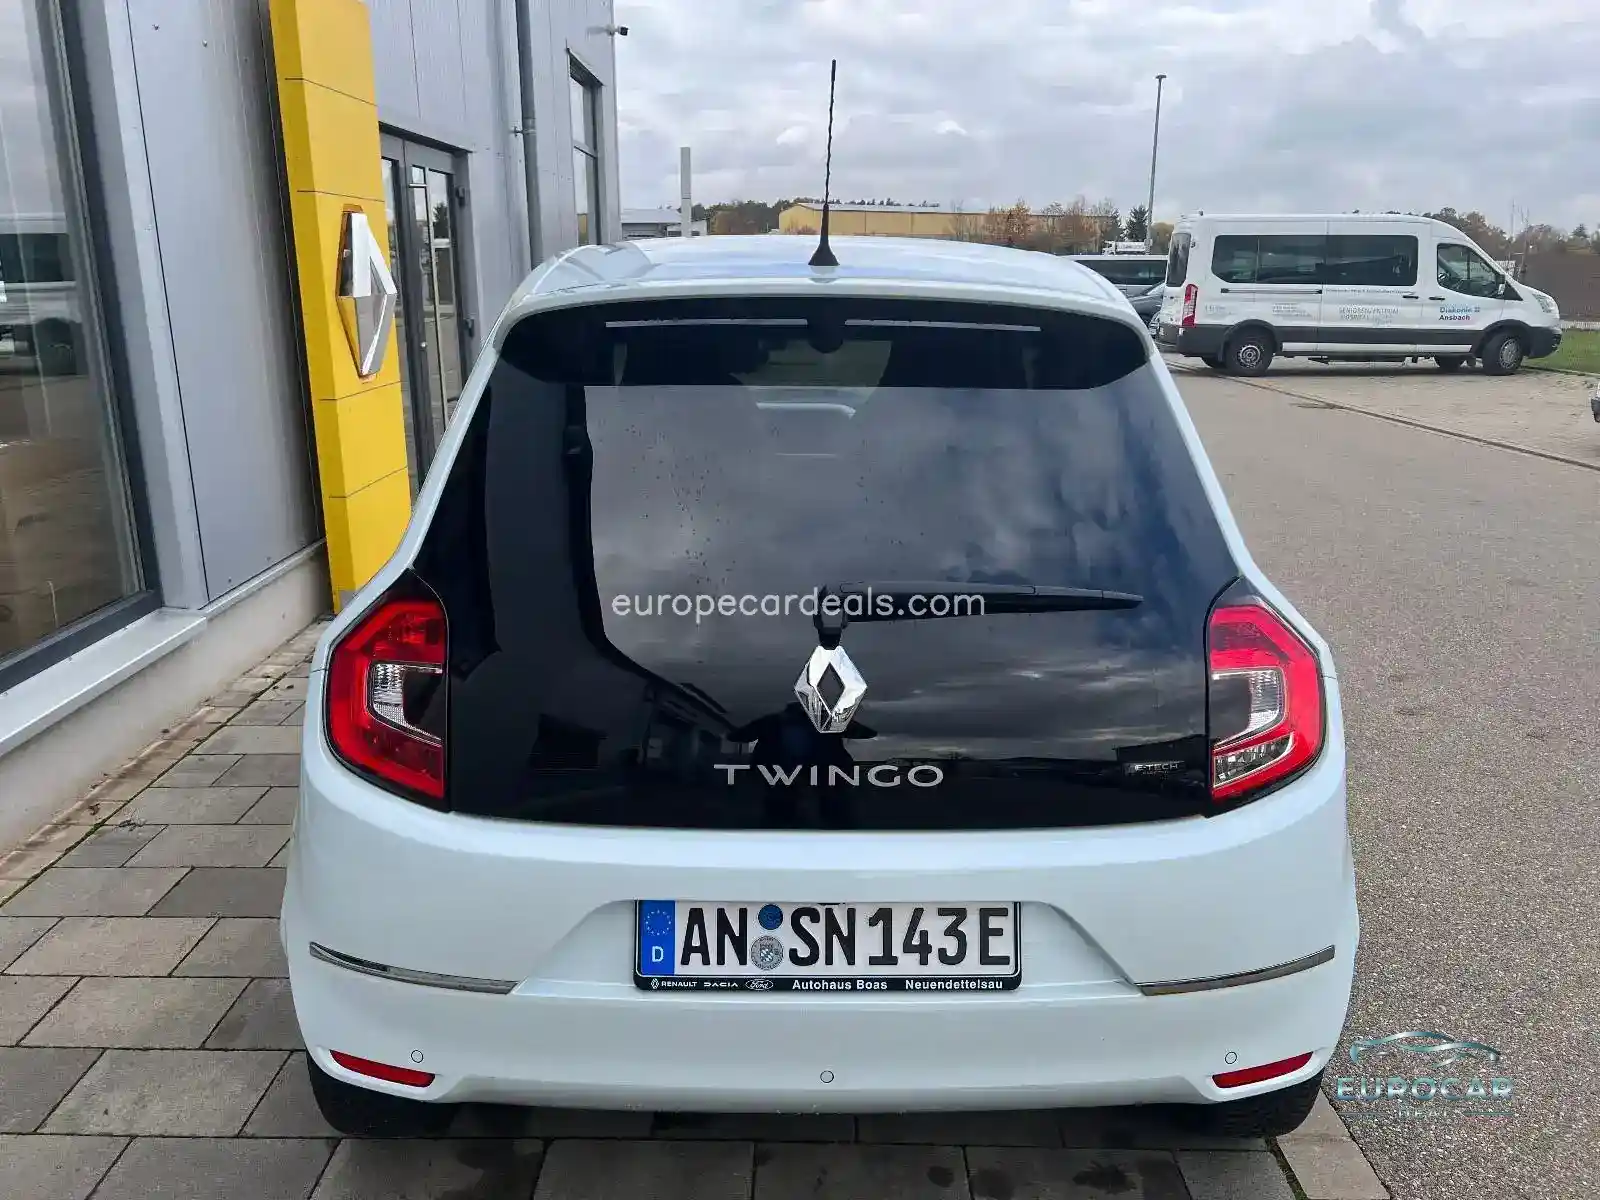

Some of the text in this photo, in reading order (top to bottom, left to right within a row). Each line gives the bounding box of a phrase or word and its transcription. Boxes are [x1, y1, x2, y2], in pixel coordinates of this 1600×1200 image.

[1134, 763, 1178, 771] E-TECH
[713, 763, 945, 788] TWINGO
[651, 945, 664, 963] D
[661, 980, 698, 988] RENAULT
[792, 979, 888, 990] Autohaus Boas
[904, 978, 1003, 990] Neuendettelsau
